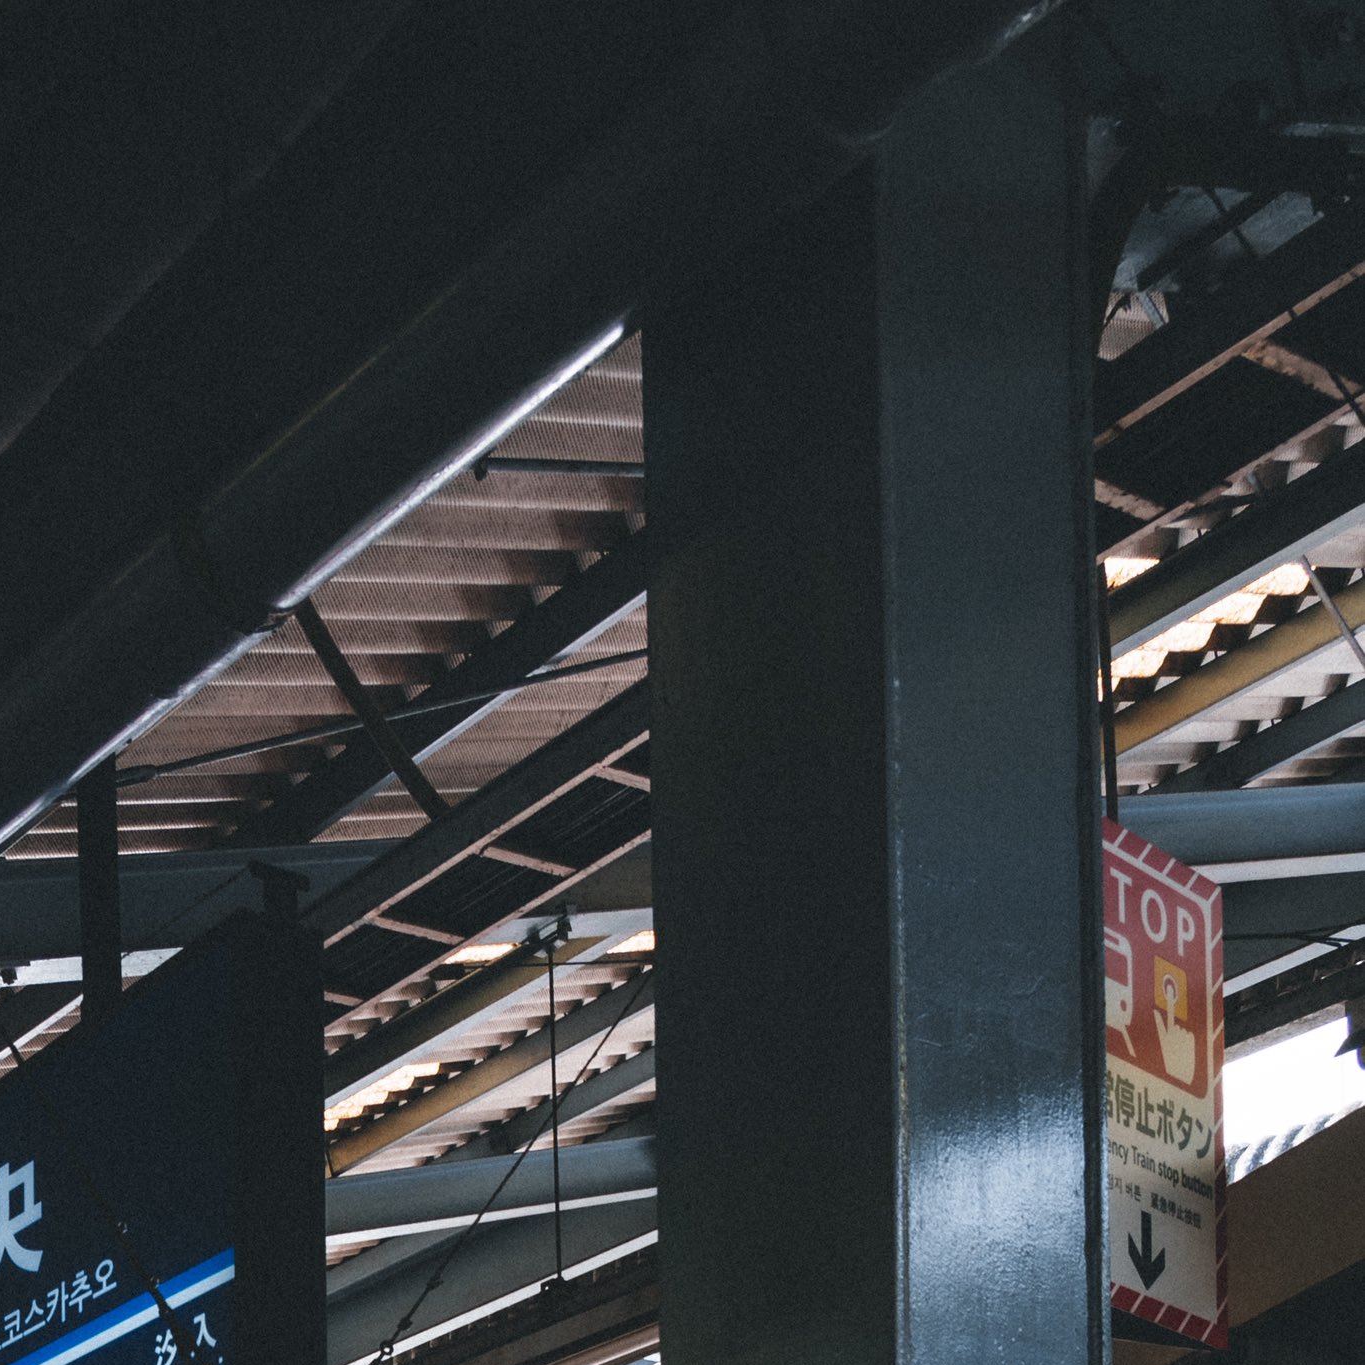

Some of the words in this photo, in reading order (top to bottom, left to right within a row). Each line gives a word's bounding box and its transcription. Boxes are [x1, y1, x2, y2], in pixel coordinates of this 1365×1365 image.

[1110, 866, 1196, 957] TOP
[1131, 1144, 1155, 1174] Train
[1158, 1160, 1179, 1188] stop
[1181, 1168, 1213, 1200] button
